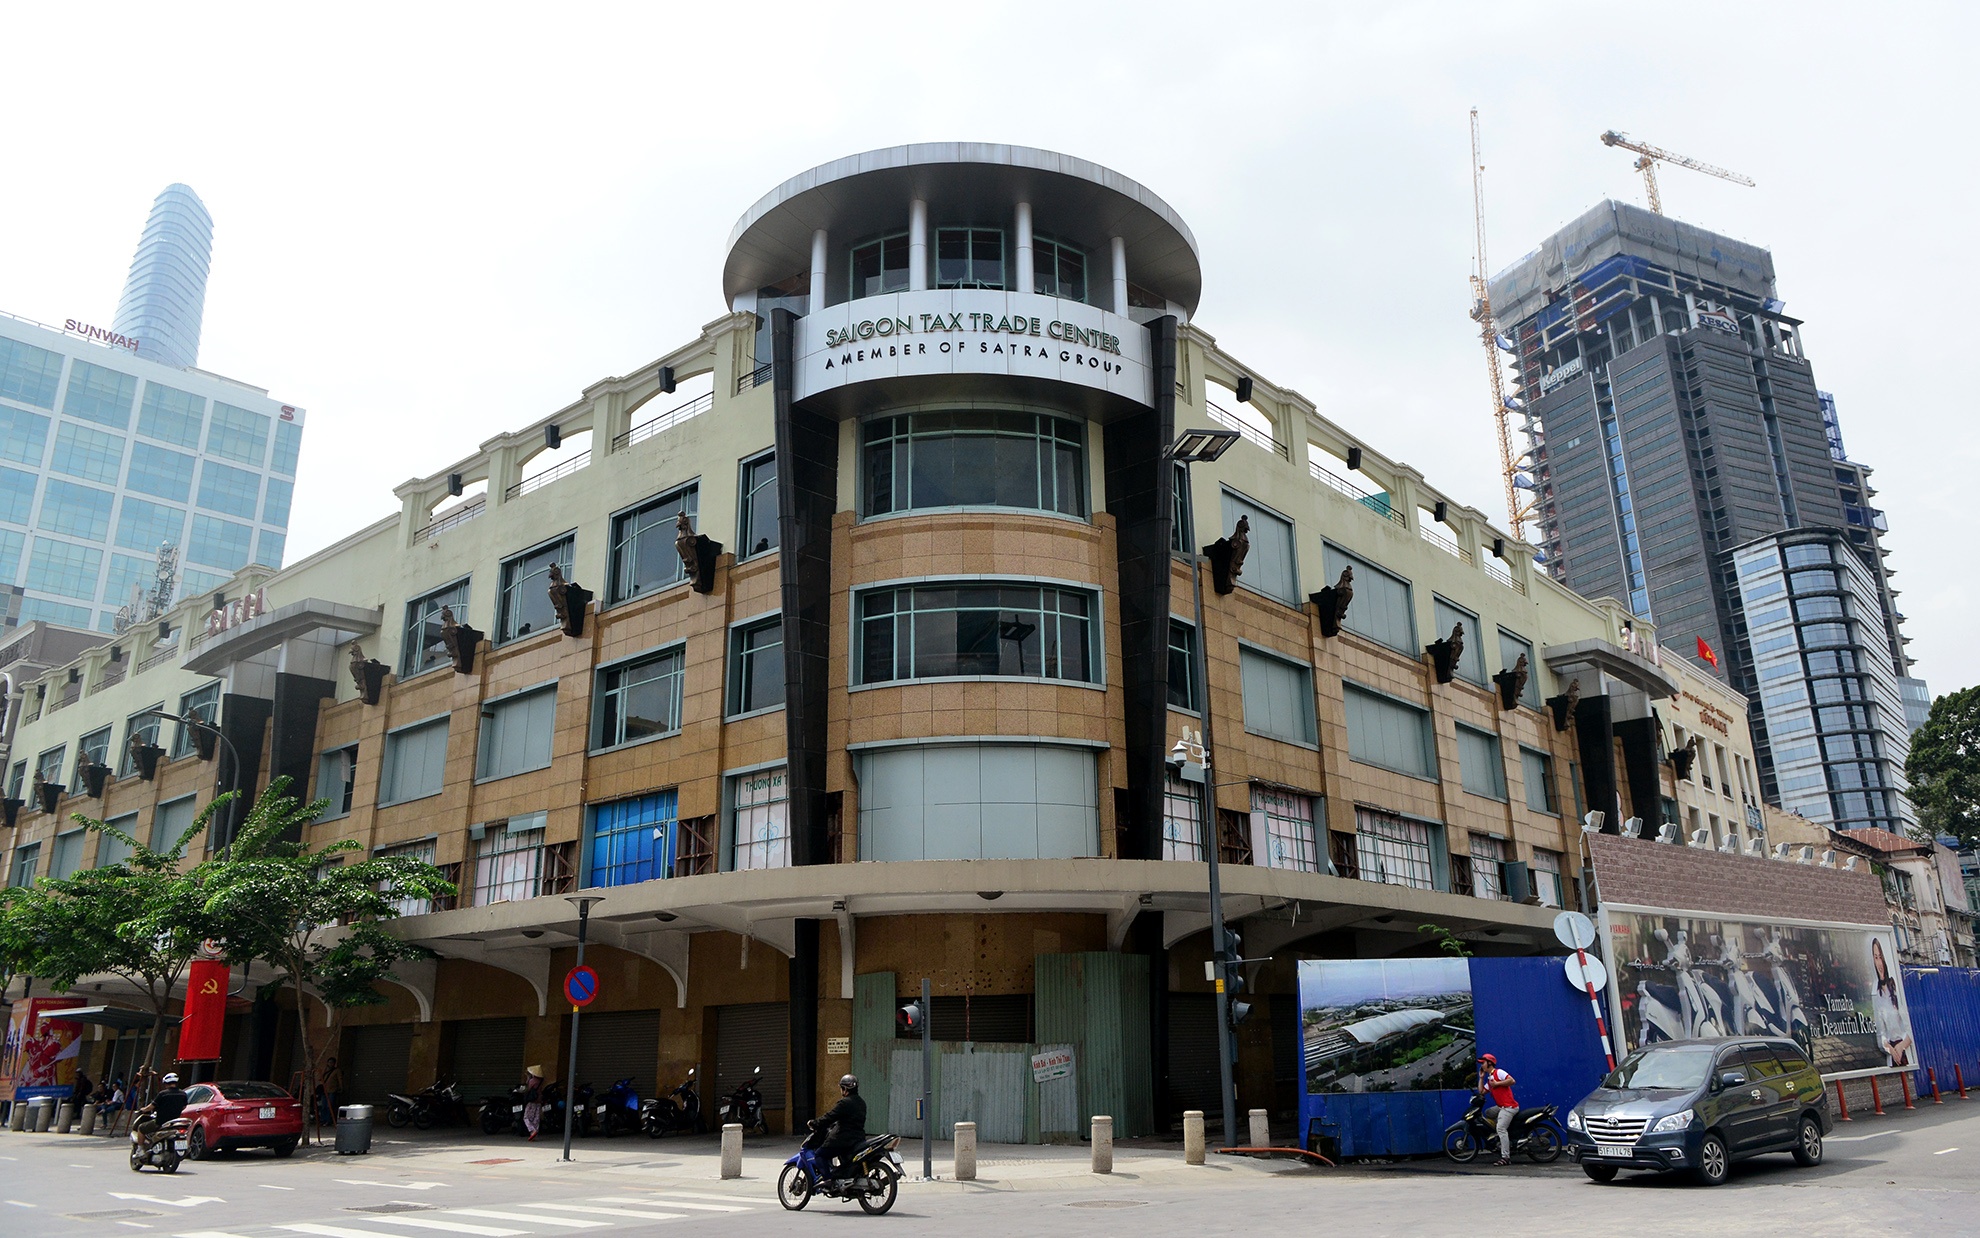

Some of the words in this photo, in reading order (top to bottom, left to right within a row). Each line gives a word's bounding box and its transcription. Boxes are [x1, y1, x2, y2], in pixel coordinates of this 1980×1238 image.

[64, 318, 139, 352] SUNWAH
[825, 315, 912, 348] SAIGON
[920, 312, 964, 333] TAX
[969, 312, 1041, 337] TRADE
[1048, 320, 1121, 355] CENTER
[825, 357, 834, 370] A
[841, 342, 927, 366] MEMBER
[939, 341, 968, 355] OF
[980, 342, 1049, 359] SATRA
[1059, 350, 1123, 375] GROUP
[1542, 359, 1580, 387] Keppel
[1823, 993, 1855, 1012] Yamaha
[1809, 1023, 1820, 1037] for
[1819, 1013, 1860, 1037] Beautiful
